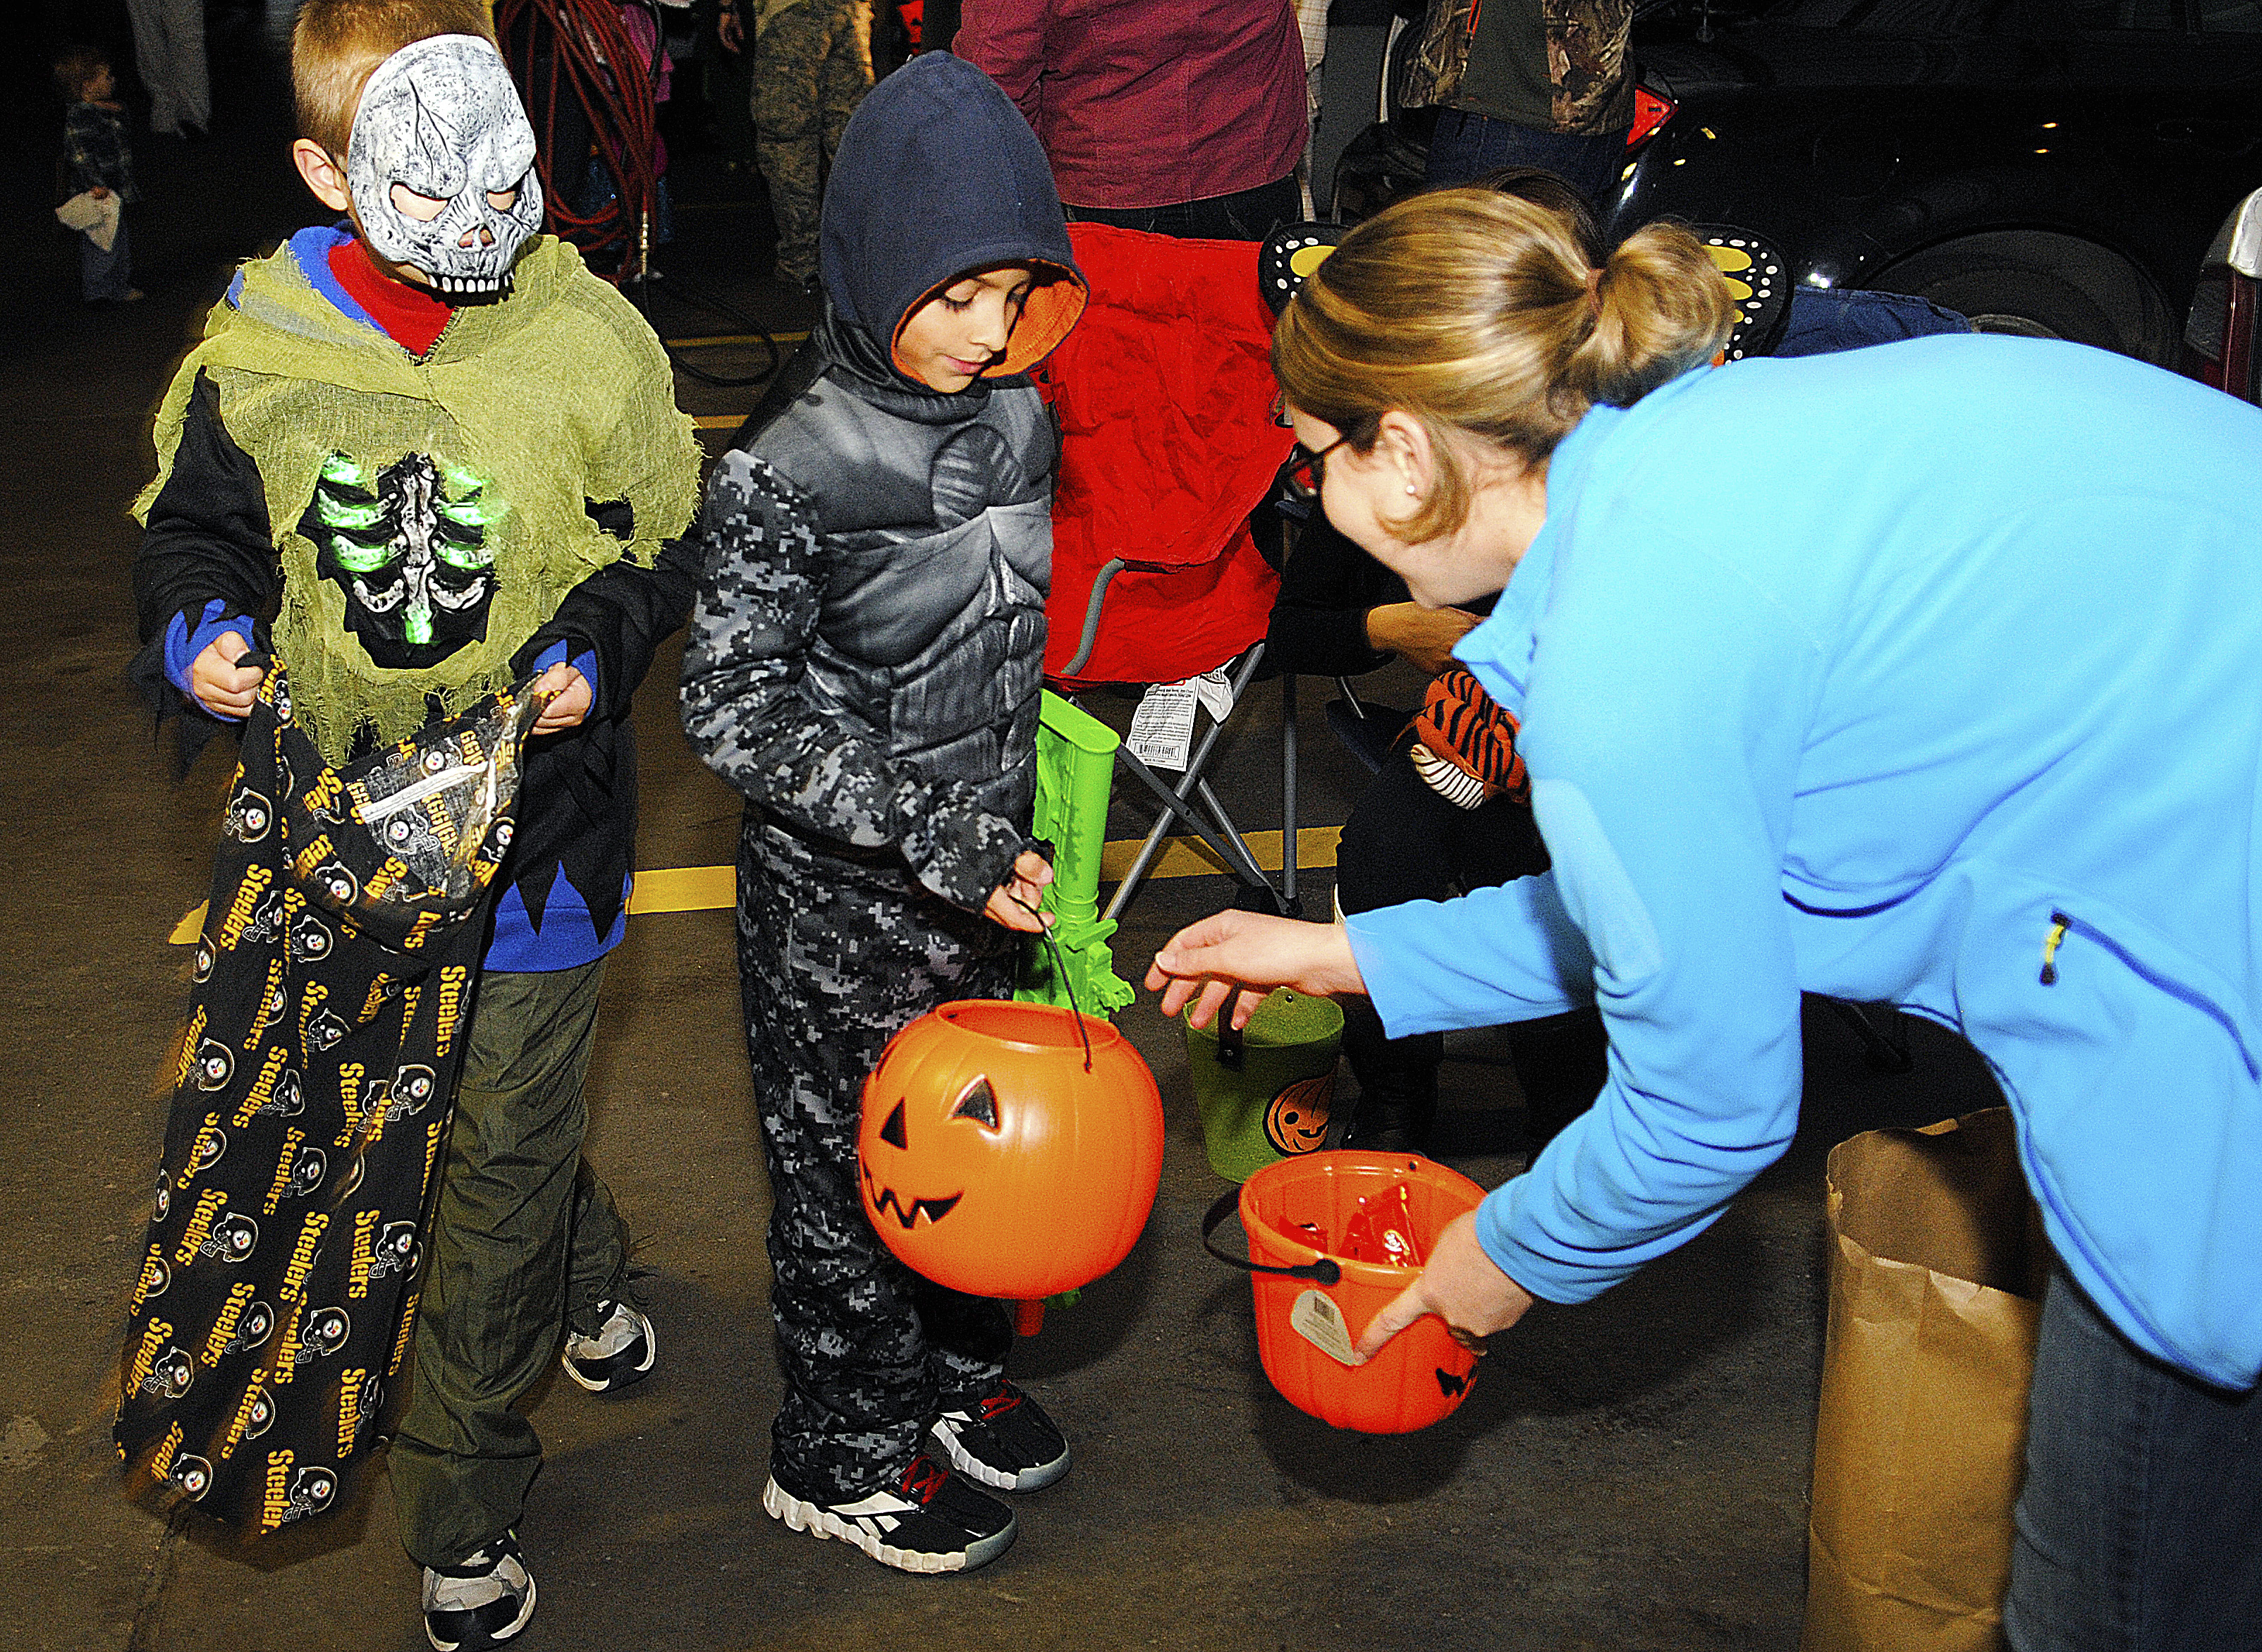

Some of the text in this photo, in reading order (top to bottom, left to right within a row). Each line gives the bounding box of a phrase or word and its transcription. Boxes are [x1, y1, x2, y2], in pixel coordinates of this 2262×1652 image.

[219, 864, 273, 951] Steelers
[176, 1004, 207, 1088] Steelers
[436, 965, 466, 1057] Steelers
[232, 1046, 288, 1128] Steelers
[334, 1063, 365, 1148] Steelers
[263, 1126, 305, 1216] Steelers
[175, 1188, 228, 1266] Steelers
[279, 1211, 329, 1302] Steelers
[348, 1209, 381, 1299] Steelers
[126, 1317, 173, 1400] Steelers
[200, 1282, 255, 1368] Steelers
[388, 1292, 420, 1376] Steelers
[337, 1368, 367, 1459] Steelers
[260, 1449, 295, 1535] Steeler
